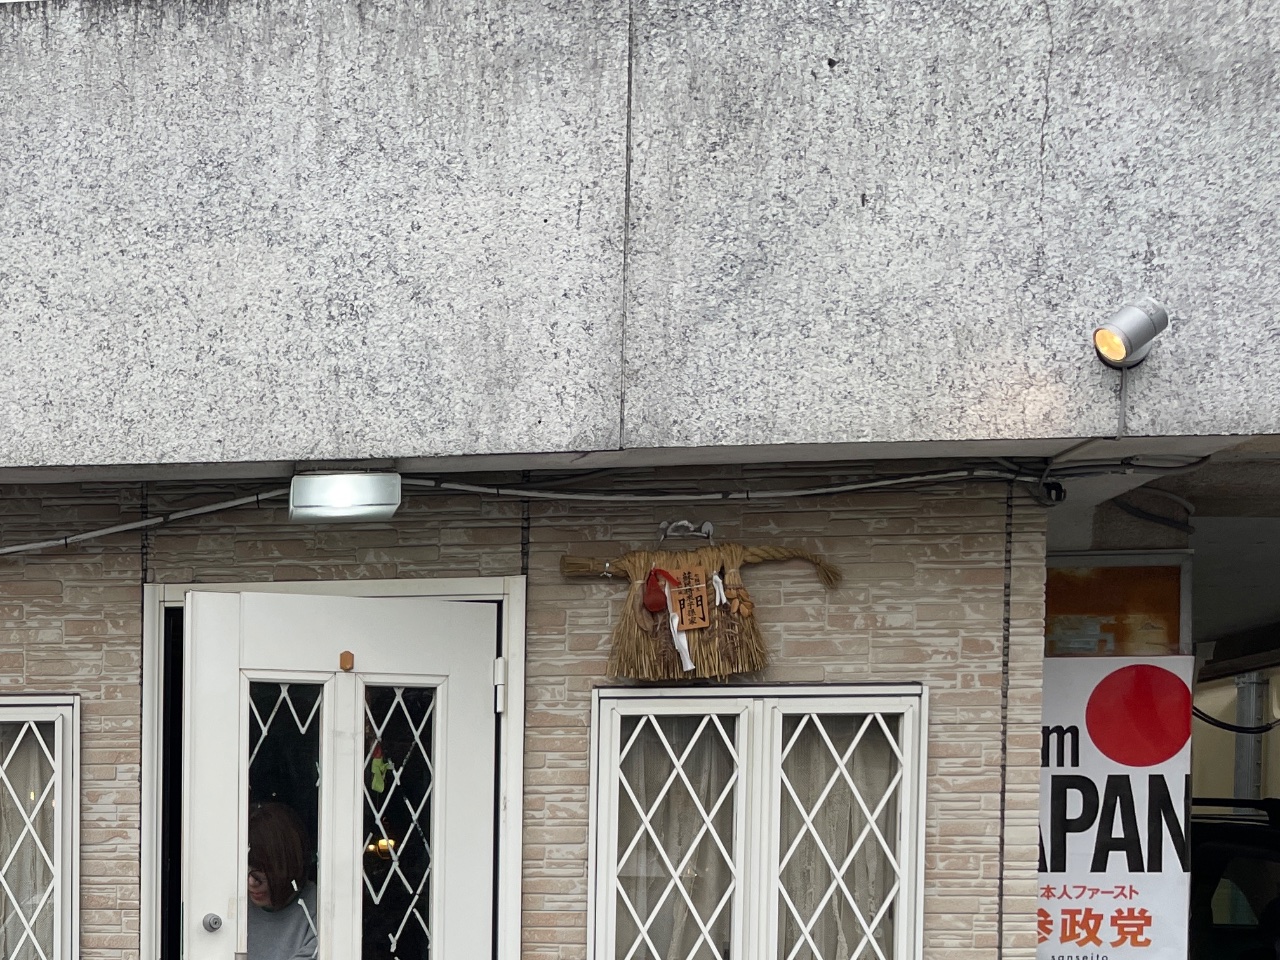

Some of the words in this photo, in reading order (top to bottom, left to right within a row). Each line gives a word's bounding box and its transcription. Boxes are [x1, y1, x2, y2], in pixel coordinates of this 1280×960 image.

[1041, 725, 1080, 767] m
[1038, 774, 1191, 872] PAN
[1040, 884, 1139, 900] 本人ファースト
